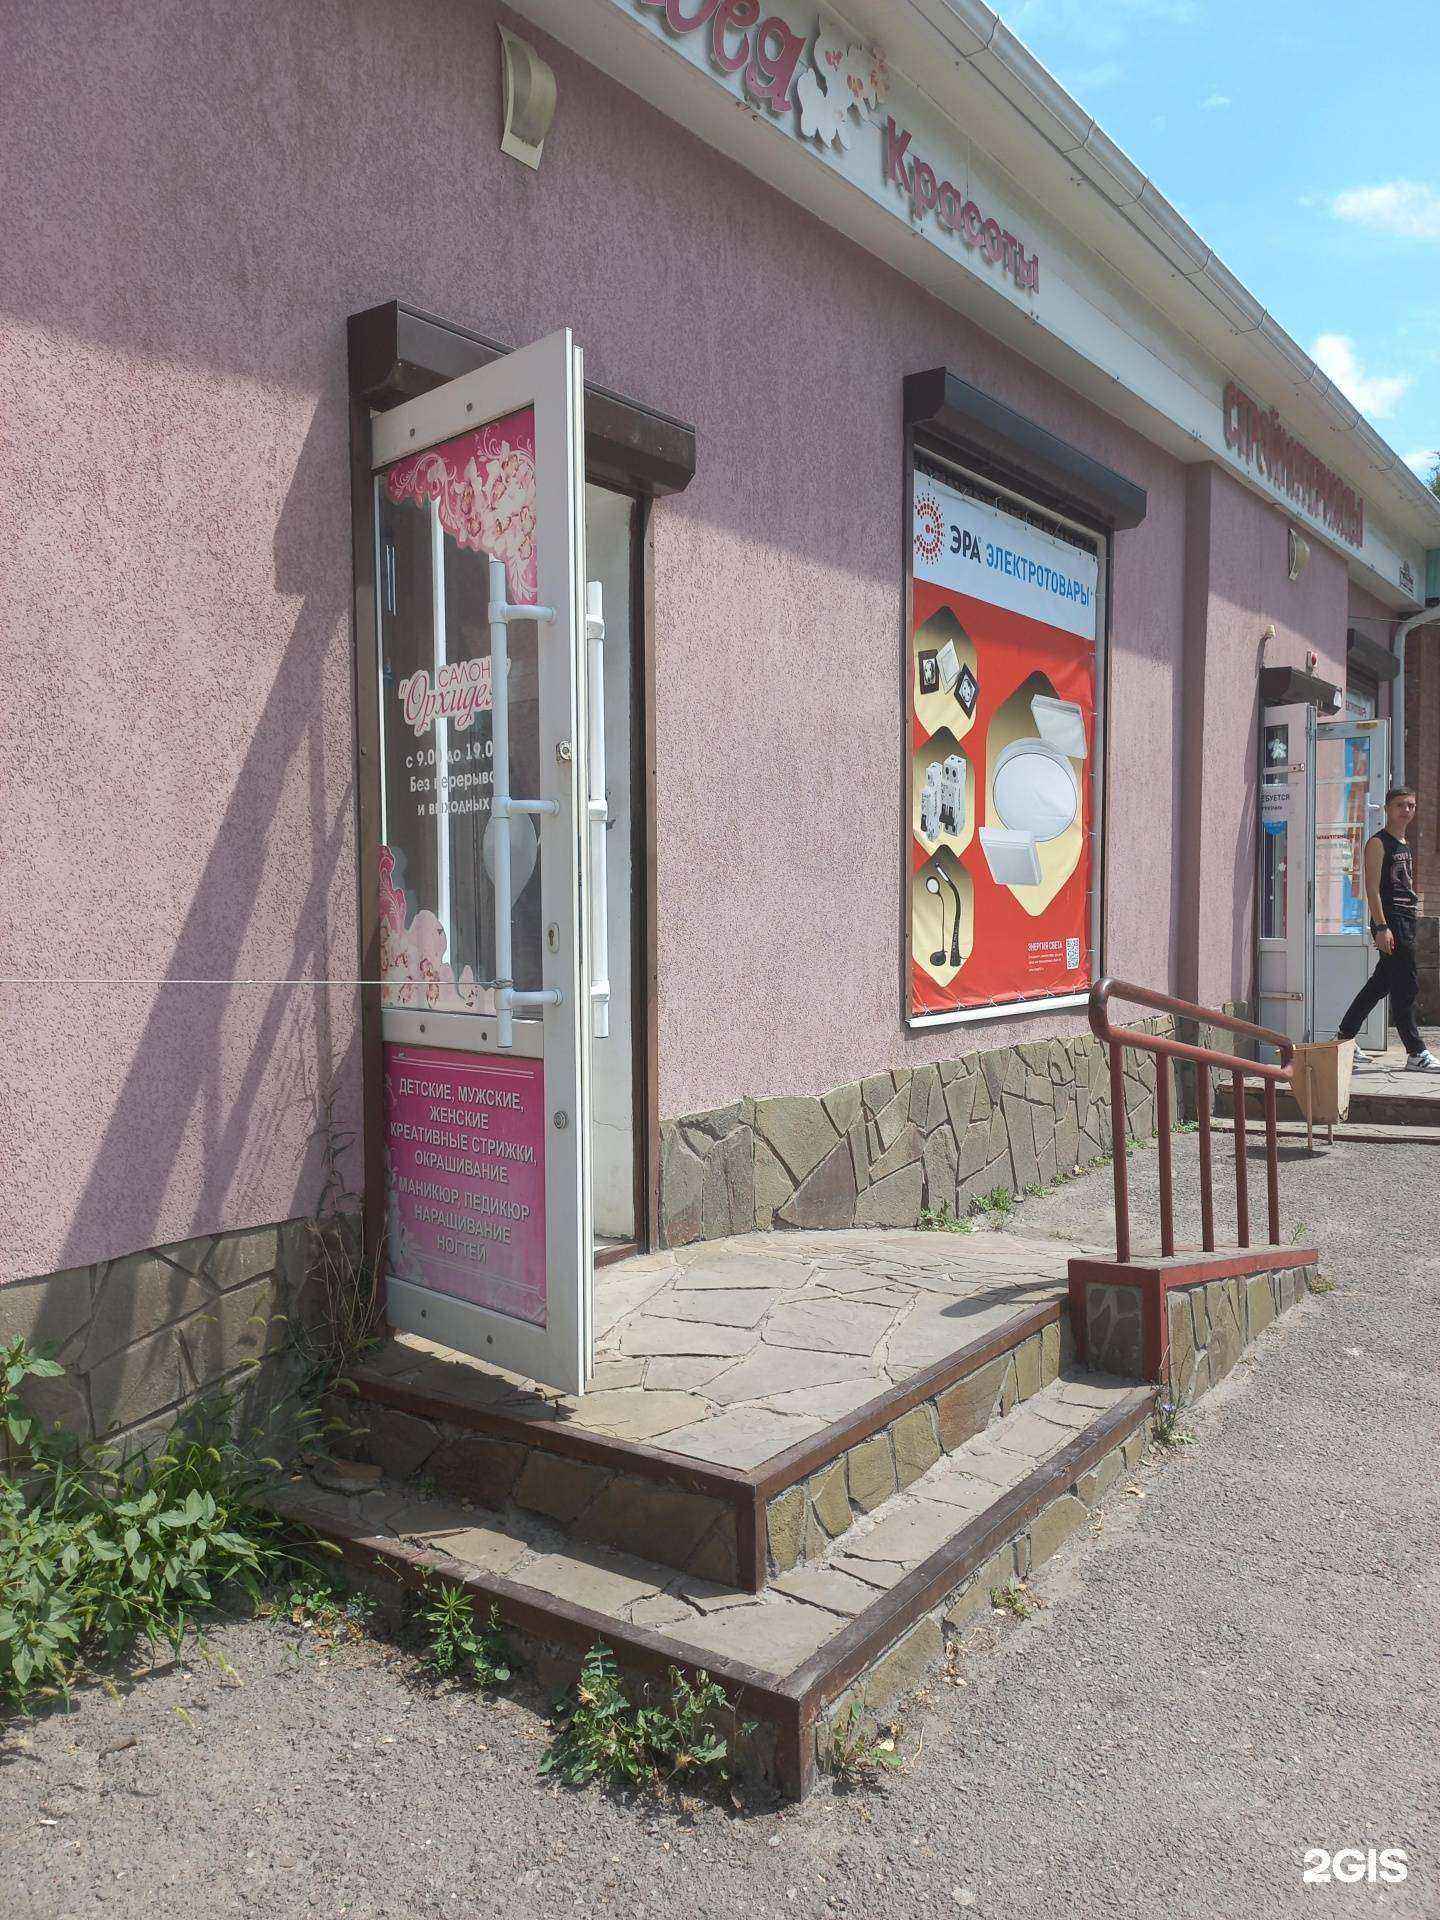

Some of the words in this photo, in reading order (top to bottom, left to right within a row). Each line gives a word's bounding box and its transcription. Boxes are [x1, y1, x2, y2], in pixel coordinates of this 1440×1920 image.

[887, 113, 1040, 295] Красоты
[950, 525, 981, 564] ЭРА
[986, 543, 1090, 607] ЭЛЕКТРОТОВАРЫ
[438, 662, 491, 688] САЛОН
[410, 776, 430, 793] Без
[417, 804, 425, 816] и
[400, 1078, 454, 1104] ДЕТСКИЕ,
[458, 1086, 525, 1112] МУЖСКИЕ,
[430, 1106, 489, 1130] ЖЕНСКИЕ
[390, 1122, 468, 1151] КРЕАТИВНЫЕ
[472, 1137, 537, 1166] СТРИЖКИ,
[415, 1150, 509, 1184] ОКРАШИВАНИЕ
[464, 1192, 530, 1221] ПЕДИКЮР
